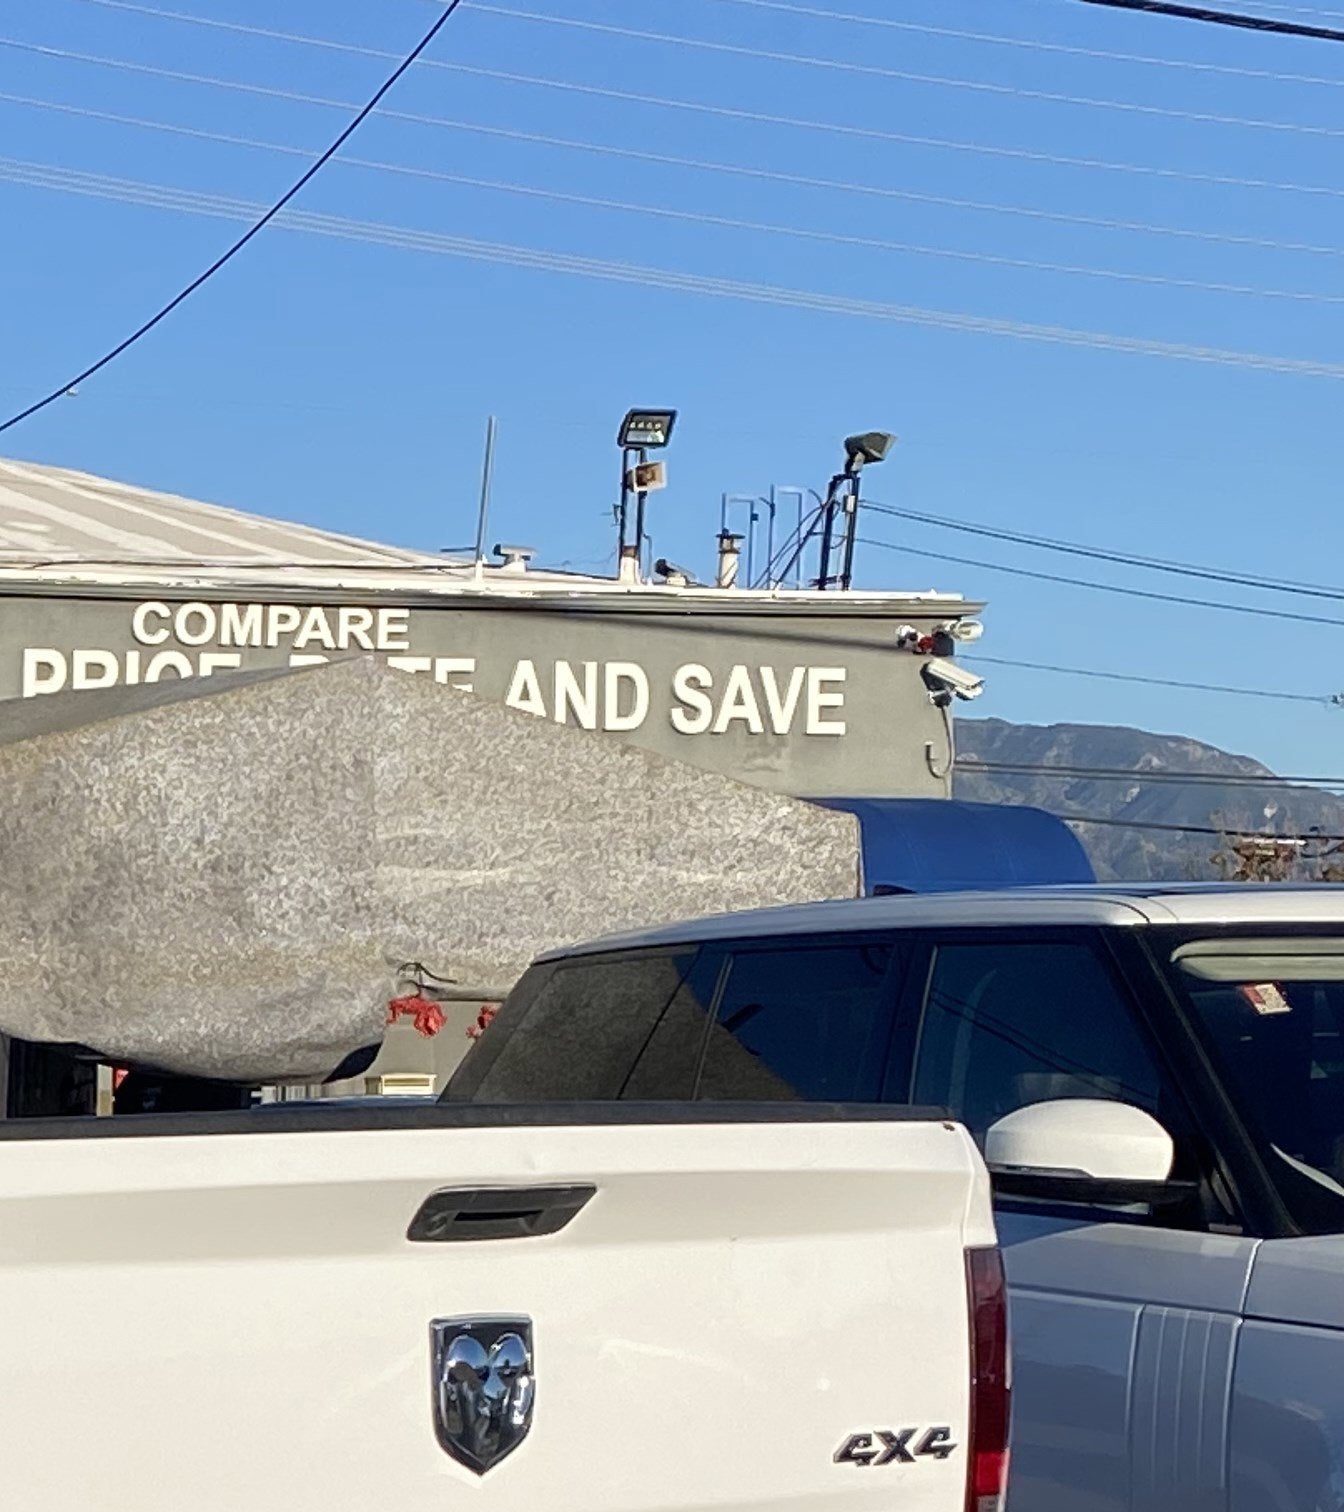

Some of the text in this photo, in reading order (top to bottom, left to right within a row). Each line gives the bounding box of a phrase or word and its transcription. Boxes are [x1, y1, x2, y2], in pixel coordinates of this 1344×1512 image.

[132, 601, 410, 651] COMPARE
[505, 659, 649, 731] AND
[670, 663, 847, 736] SAVE
